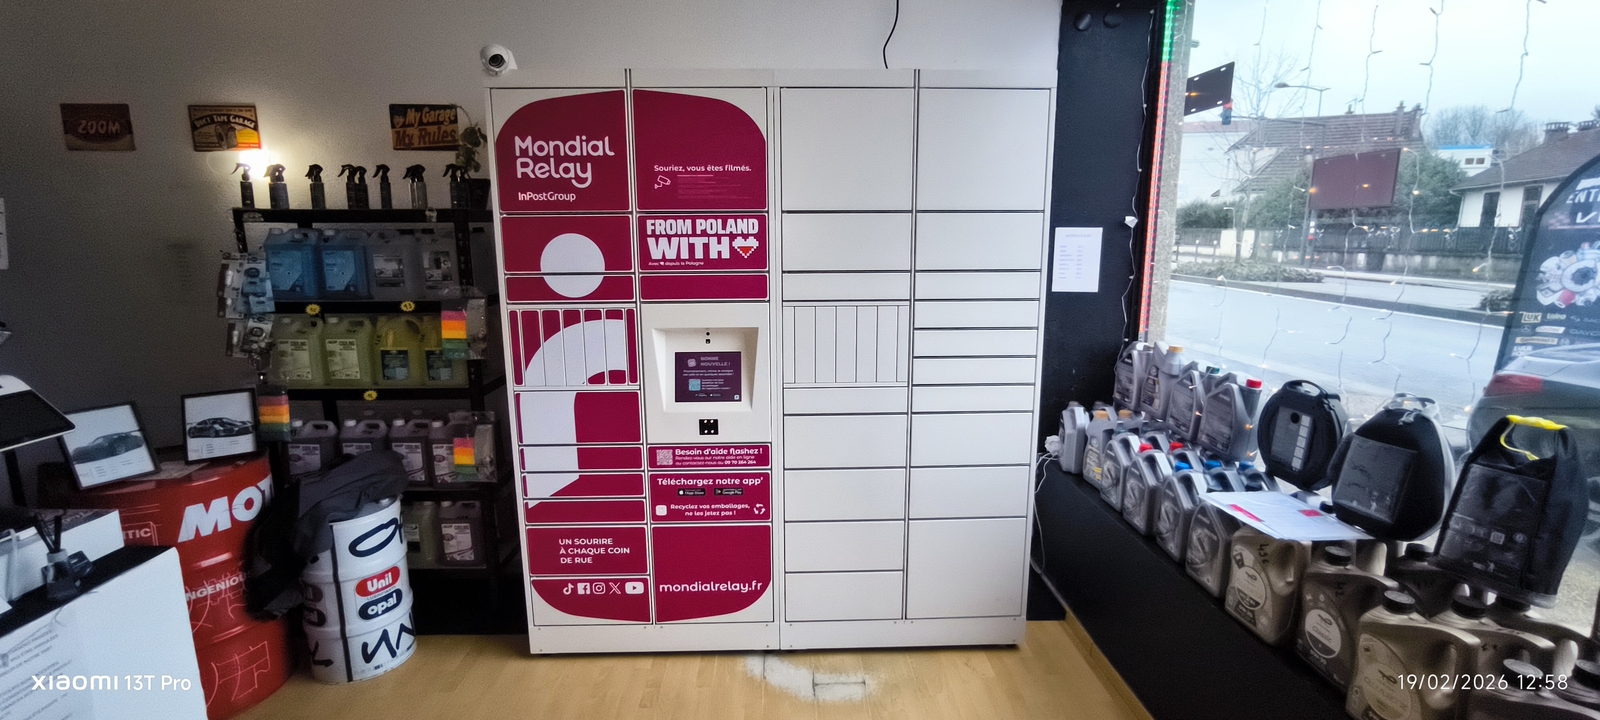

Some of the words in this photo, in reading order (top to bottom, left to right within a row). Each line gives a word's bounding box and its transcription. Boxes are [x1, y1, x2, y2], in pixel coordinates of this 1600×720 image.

[194, 116, 211, 128] DUCT
[229, 115, 256, 129] GARAGE
[405, 108, 420, 129] My
[422, 107, 456, 126] Garage
[77, 119, 121, 135] ZOOM
[394, 130, 414, 149] My
[418, 125, 457, 146] Rules
[514, 135, 615, 156] Mondial
[516, 157, 592, 188] Relay
[654, 164, 685, 172] Souriez,
[707, 164, 723, 172] êtes
[725, 164, 752, 172] filmés.
[646, 219, 692, 235] FROM
[695, 218, 759, 235] POLAND
[646, 236, 731, 260] WITH
[729, 447, 759, 455] flashez
[657, 478, 713, 486] Téléchargez
[715, 477, 740, 485] notre
[742, 476, 763, 486] app'
[123, 528, 153, 540] TIC
[574, 537, 613, 545] SOURIRE
[559, 546, 567, 555] À
[568, 547, 606, 555] CHAQUE
[608, 546, 630, 555] COIN
[560, 556, 573, 564] DE
[574, 556, 593, 564] RUE
[366, 571, 393, 593] Unil
[659, 580, 763, 593] mondialrelay.fr
[367, 592, 397, 615] opal
